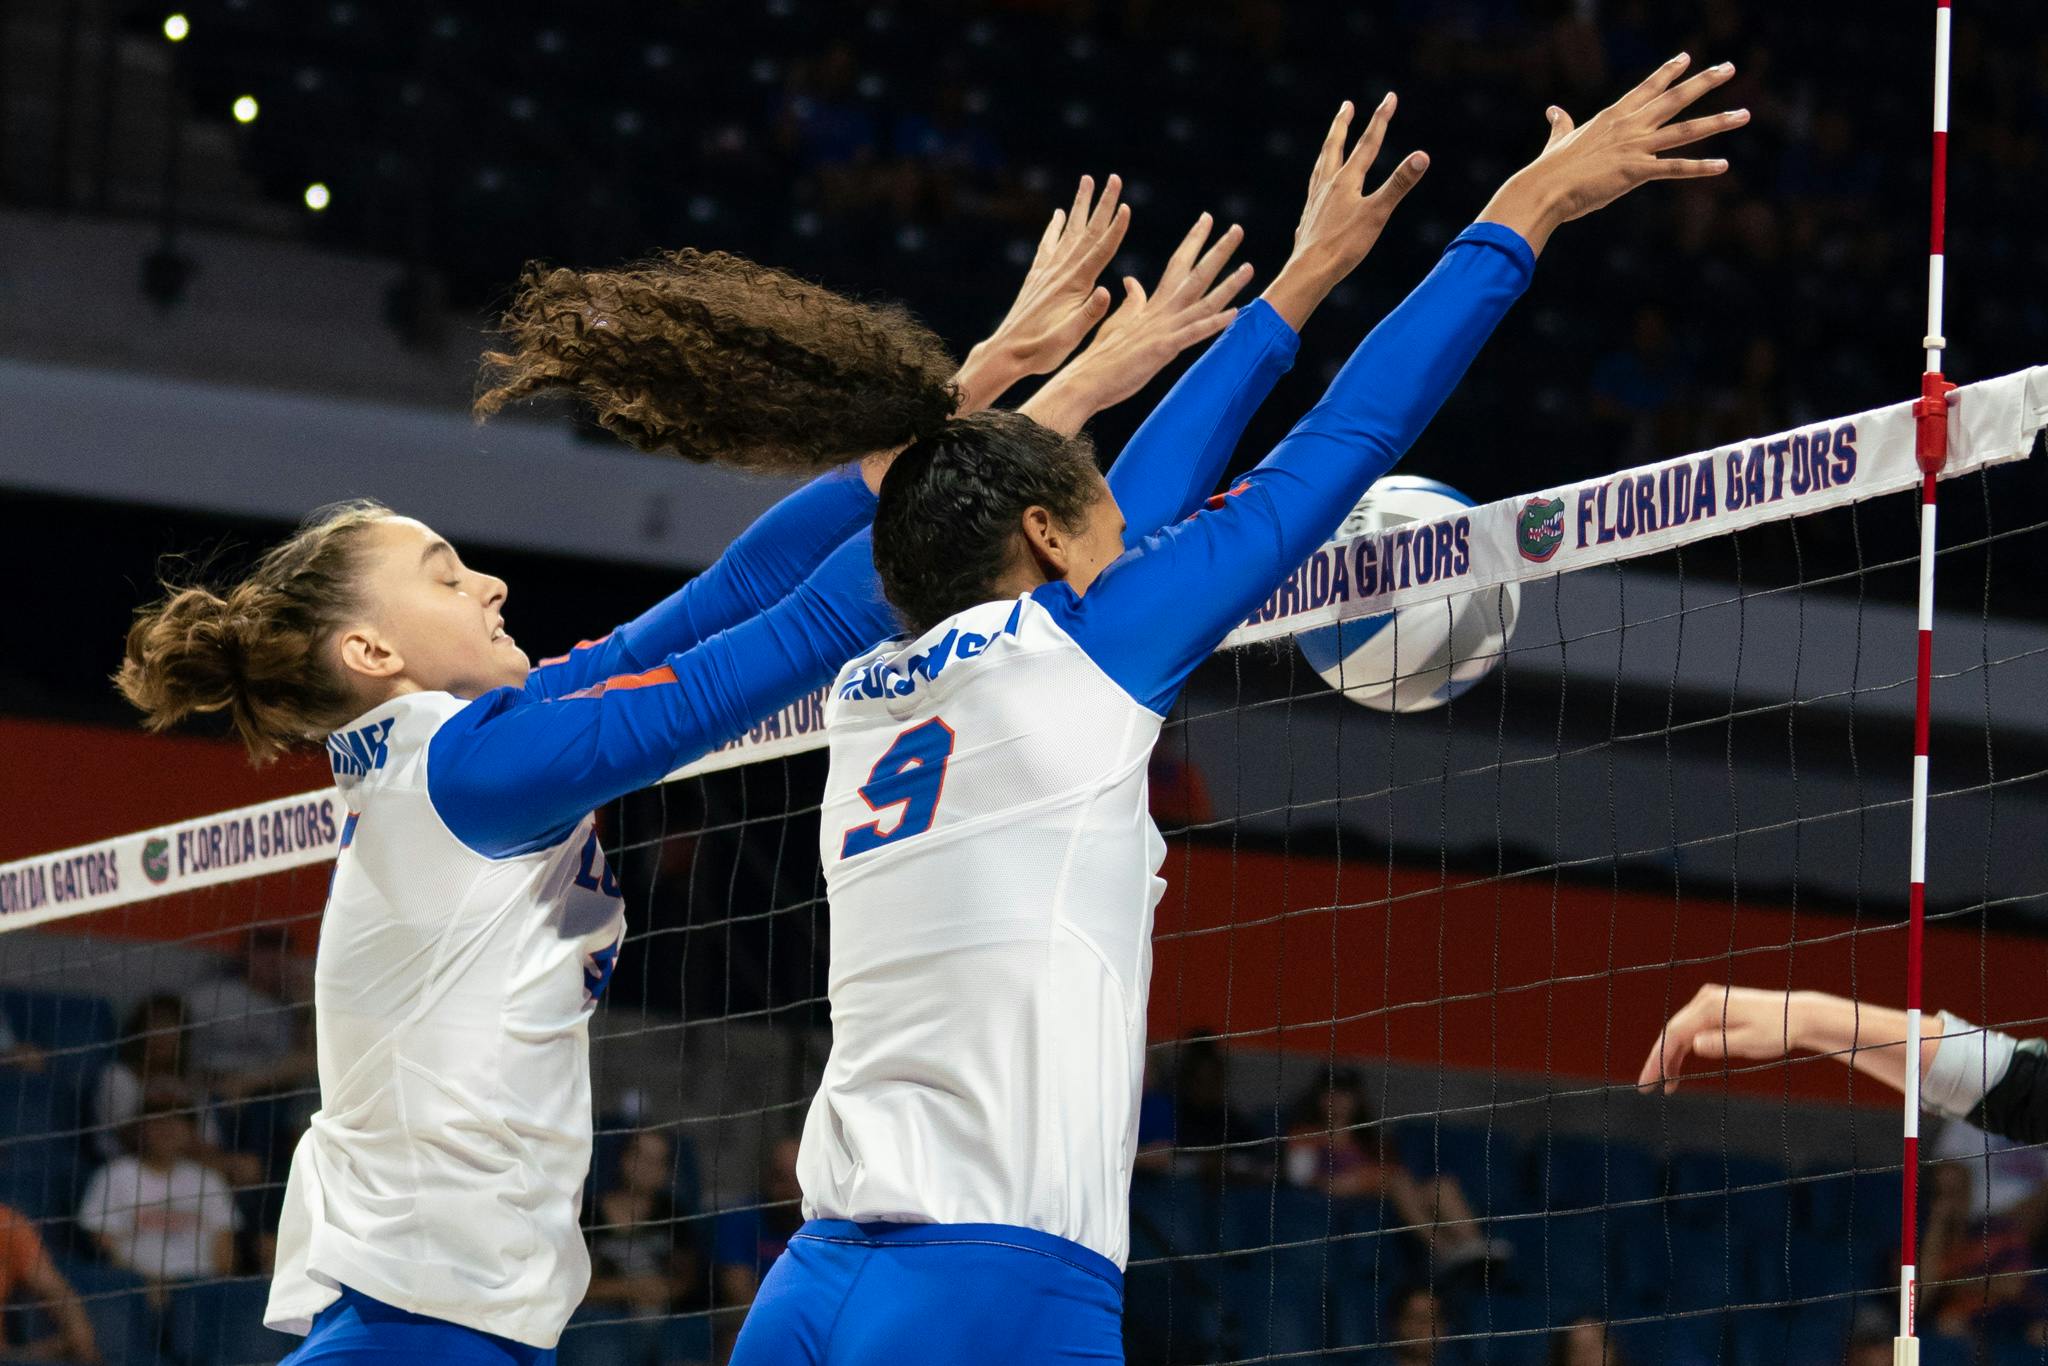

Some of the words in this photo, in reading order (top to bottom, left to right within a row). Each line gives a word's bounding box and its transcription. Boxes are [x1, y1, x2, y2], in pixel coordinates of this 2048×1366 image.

[1575, 456, 1717, 549] FLORIDA
[1725, 422, 1858, 512] GATORS
[1354, 516, 1472, 599] GATORS
[840, 715, 956, 861] 9
[51, 848, 119, 904] GATORS
[177, 817, 256, 876] FLORIDA
[259, 799, 338, 860] GATORS
